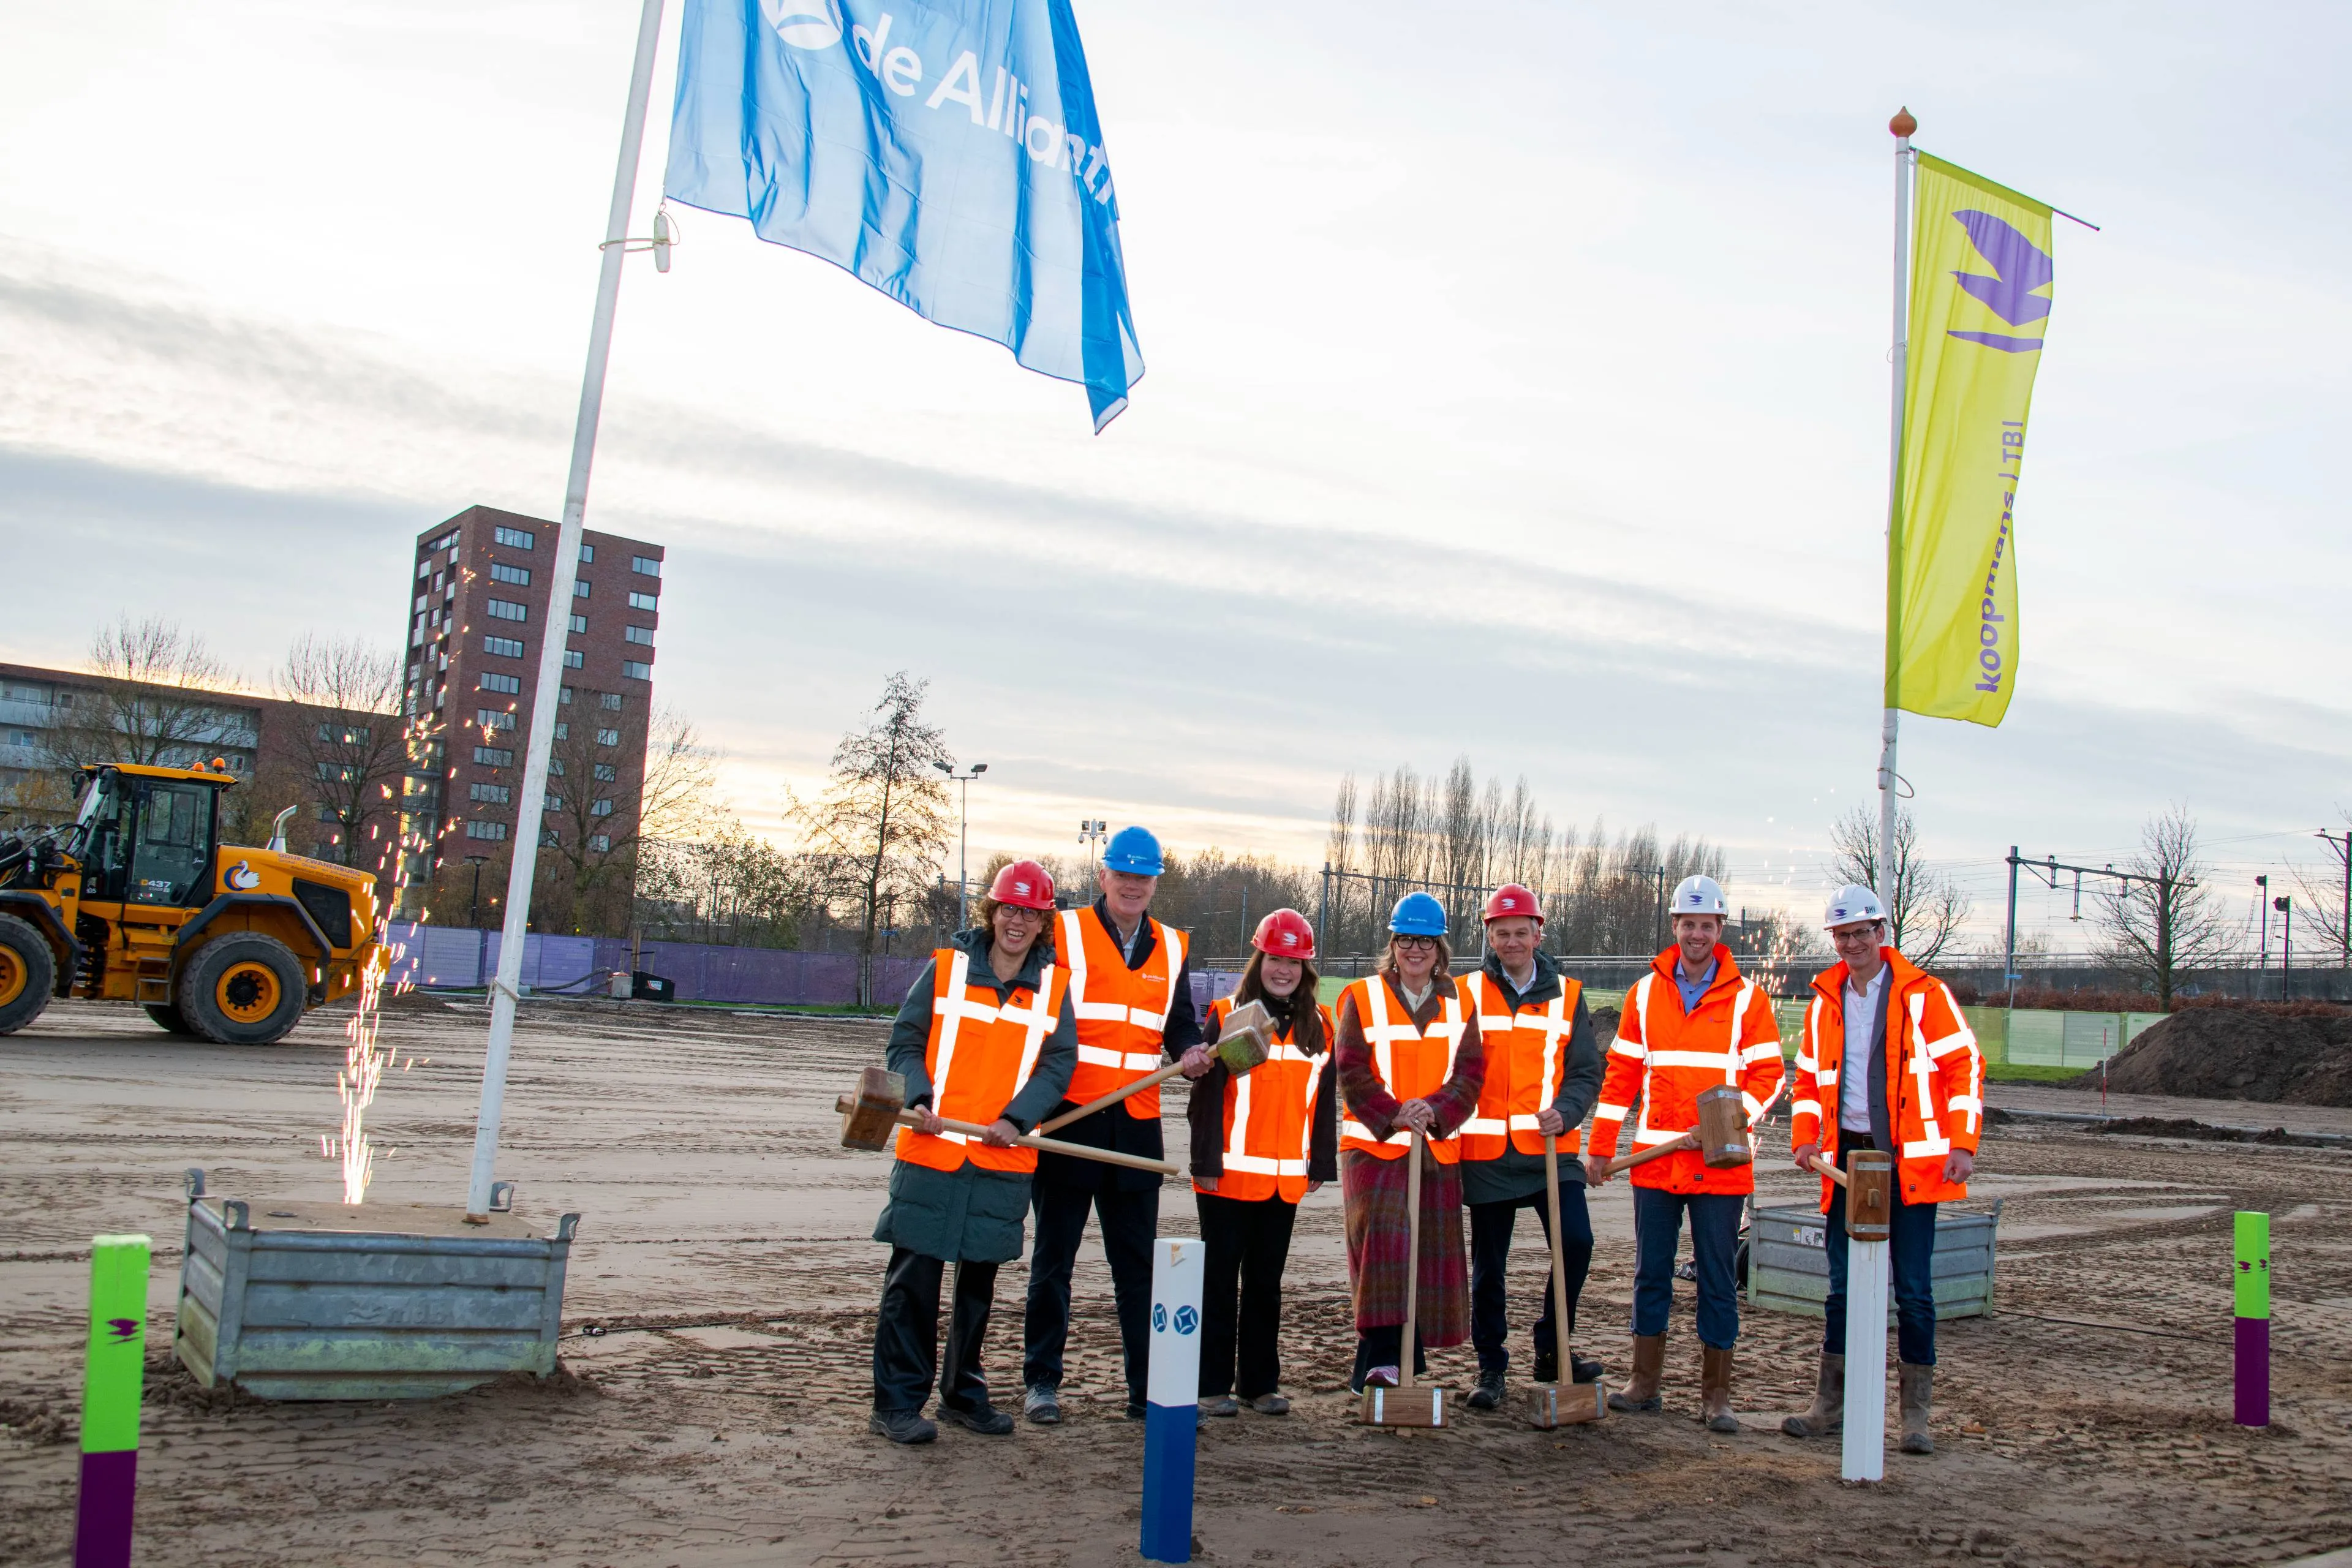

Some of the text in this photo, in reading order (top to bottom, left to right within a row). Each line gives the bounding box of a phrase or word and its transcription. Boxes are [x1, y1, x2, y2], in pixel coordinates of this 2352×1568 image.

[852, 12, 922, 97] de
[1975, 491, 2014, 693] koopmans
[2002, 421, 2023, 463] TBI
